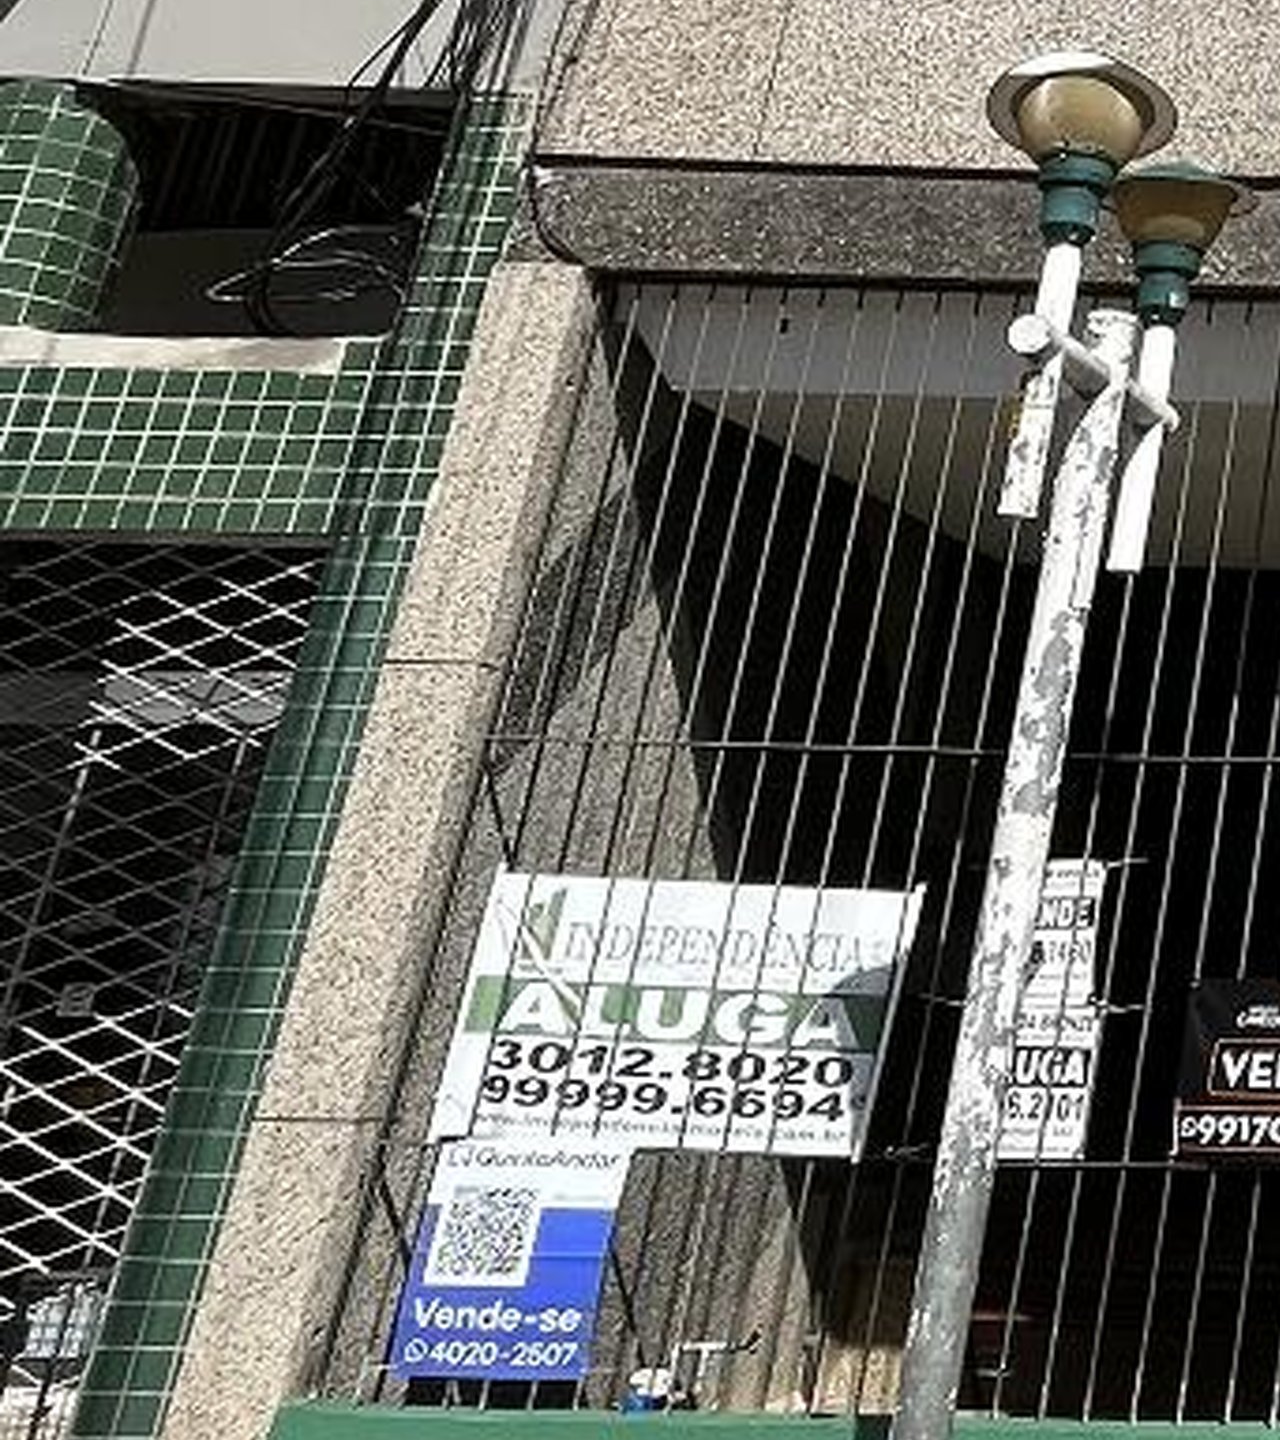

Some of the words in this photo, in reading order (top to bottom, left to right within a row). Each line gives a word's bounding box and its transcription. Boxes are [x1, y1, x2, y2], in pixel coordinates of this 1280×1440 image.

[499, 981, 857, 1049] ALUGA
[489, 1040, 853, 1087] 3012.8020
[482, 1075, 846, 1123] 99999.6694
[414, 1297, 582, 1332] Vende-se
[430, 1339, 579, 1366] 4020-2507
